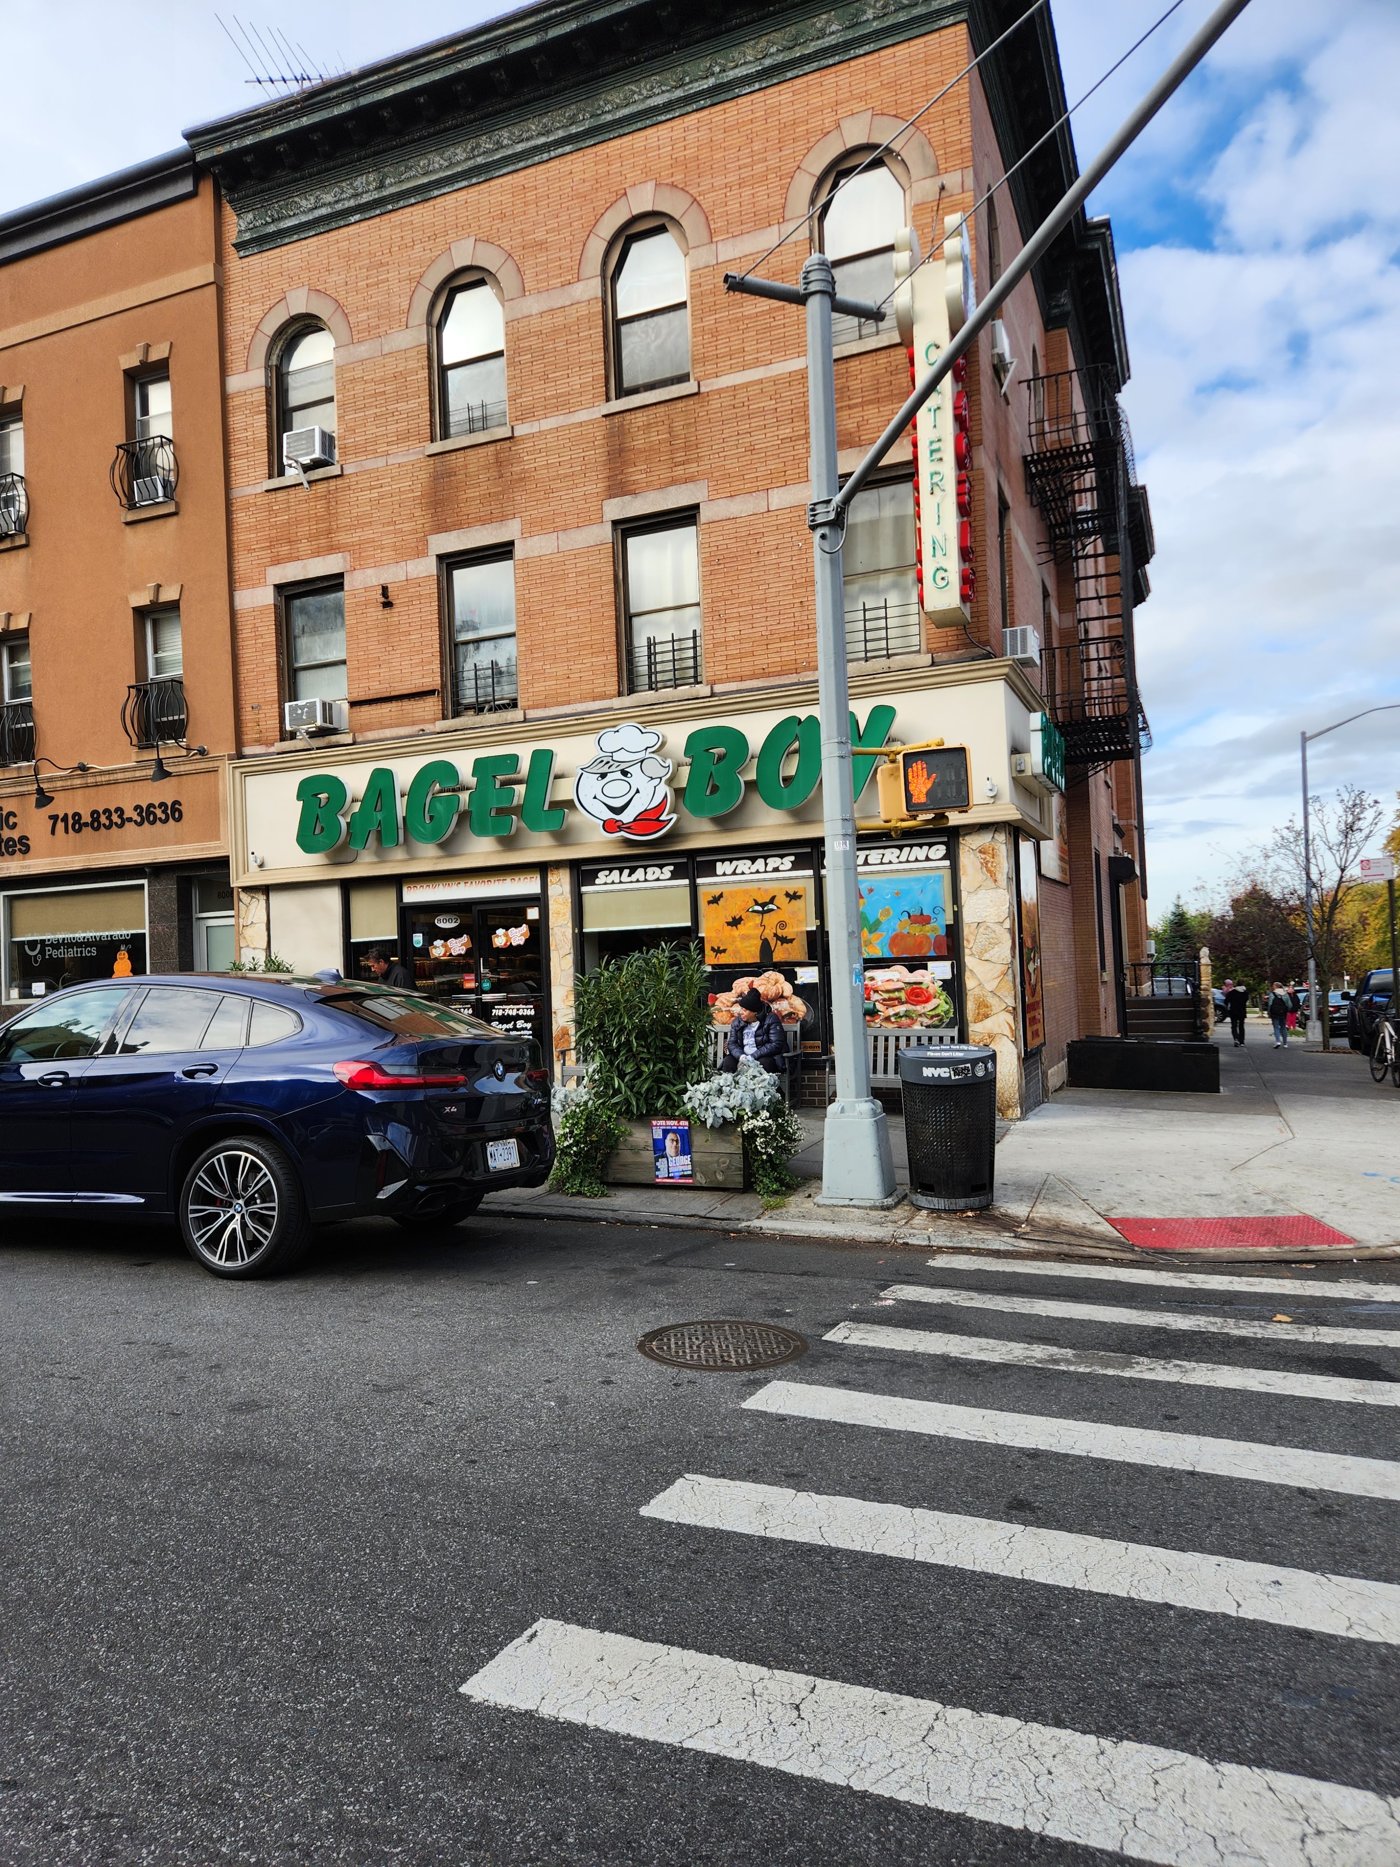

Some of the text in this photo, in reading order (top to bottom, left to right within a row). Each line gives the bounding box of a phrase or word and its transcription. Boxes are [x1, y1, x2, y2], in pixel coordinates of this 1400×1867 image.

[296, 704, 897, 854] BAGEL BOY
[47, 799, 183, 836] 718-833-3636
[824, 844, 947, 866] TERING
[716, 855, 795, 876] WRAPS
[595, 865, 674, 885] SALADS
[436, 917, 459, 925] 8002
[45, 945, 97, 958] Pediatrics
[491, 1008, 535, 1016] 718-748-0366
[516, 1020, 532, 1029] Boy
[922, 1066, 950, 1078] NYC
